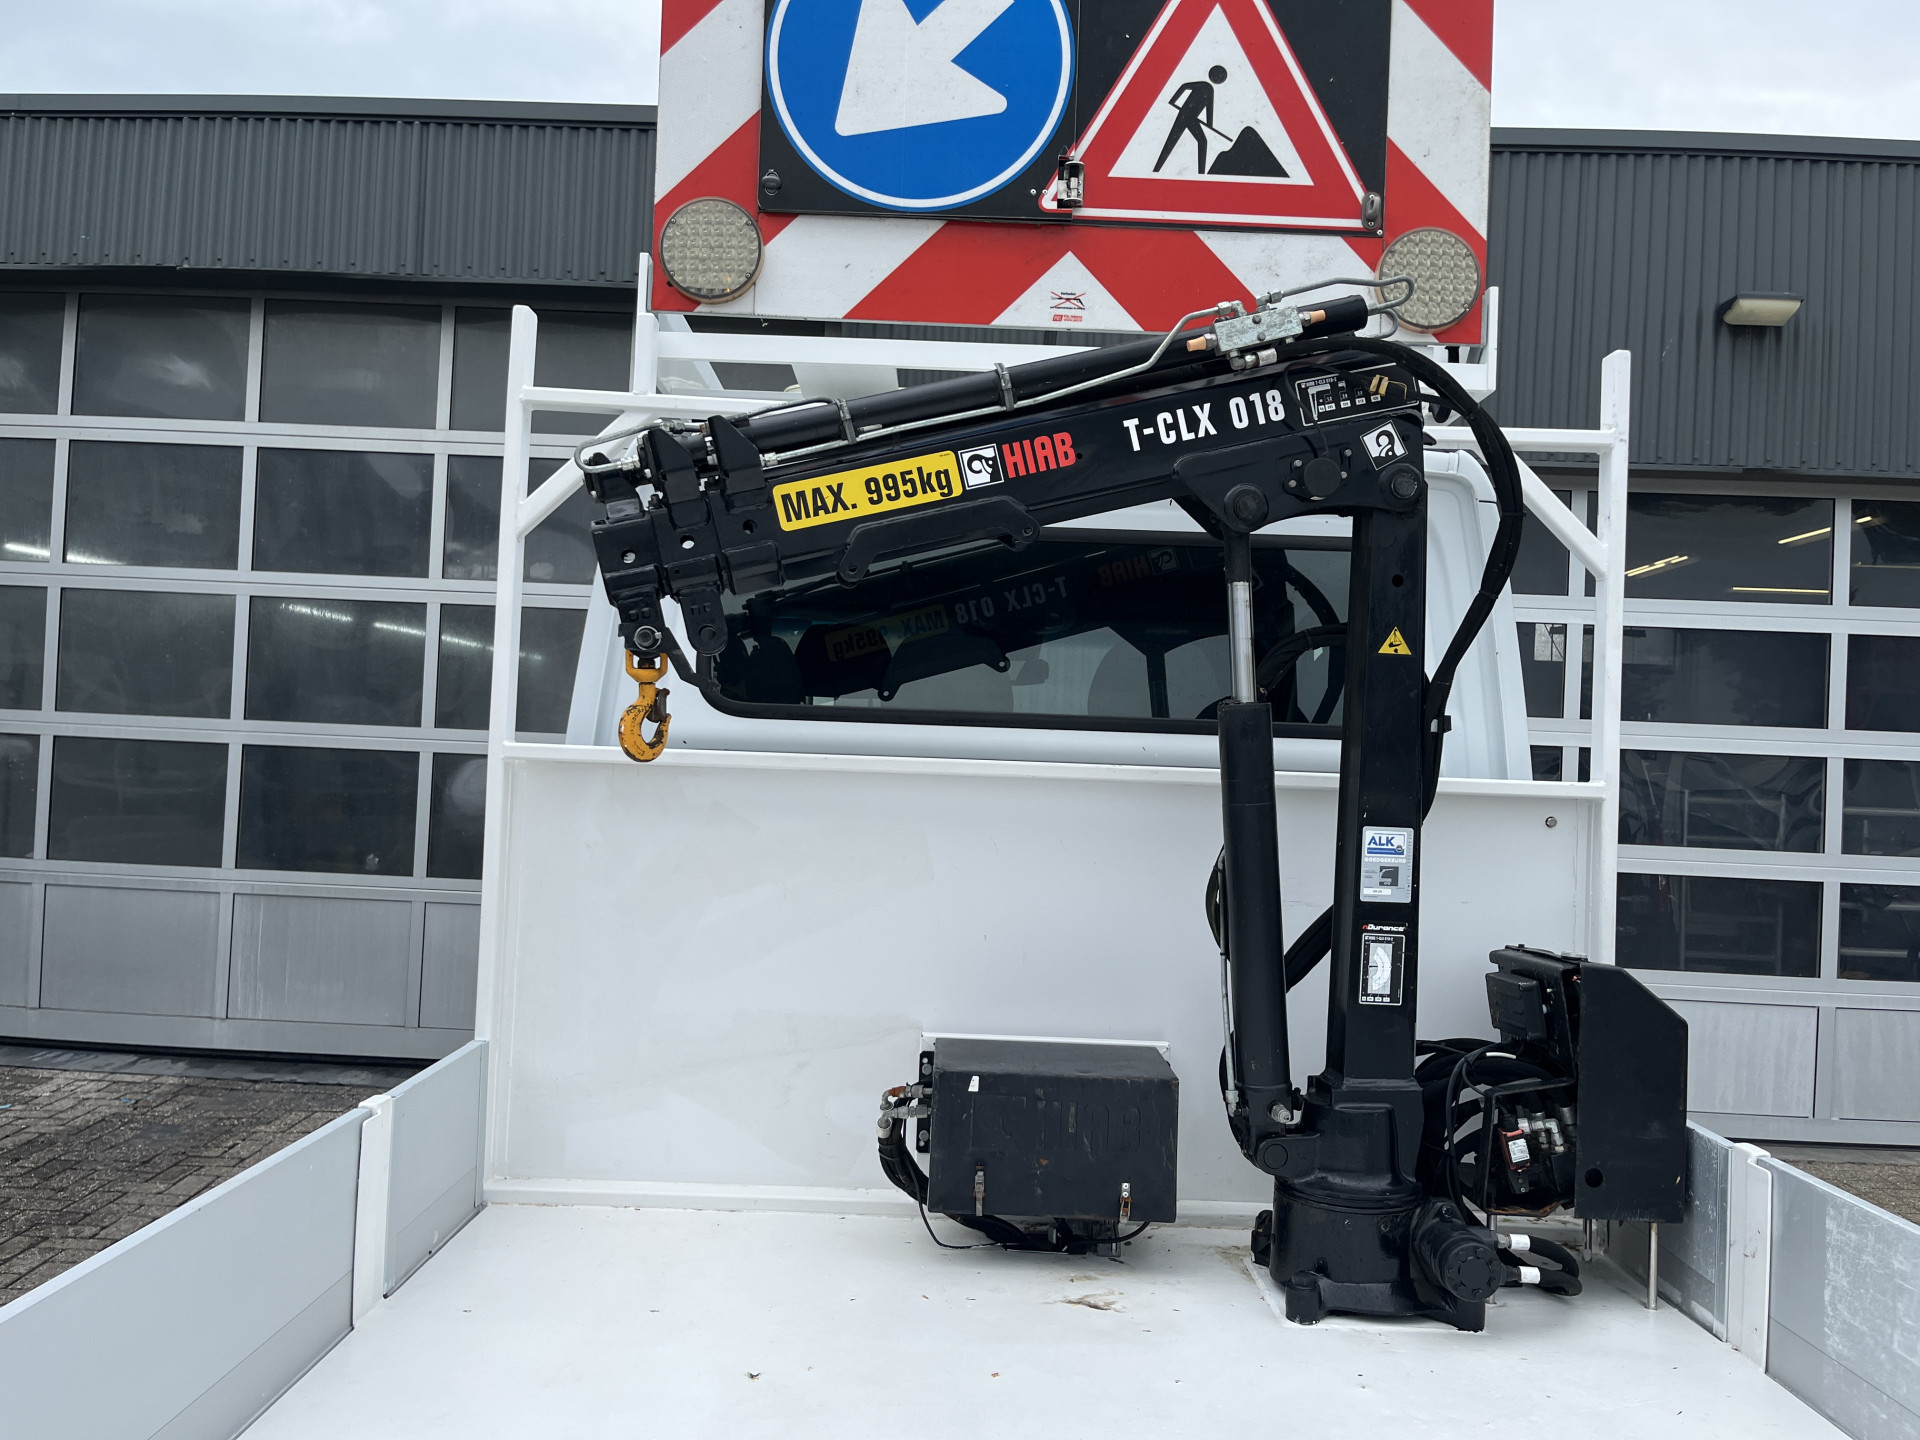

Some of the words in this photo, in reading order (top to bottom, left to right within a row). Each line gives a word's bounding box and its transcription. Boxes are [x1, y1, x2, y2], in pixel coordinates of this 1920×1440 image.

[1123, 402, 1217, 452] T-CLX
[1229, 389, 1285, 430] 018
[1002, 431, 1076, 479] HIAB
[780, 482, 858, 523] MAX.
[864, 465, 952, 506] 995kg
[1368, 835, 1395, 847] ALK
